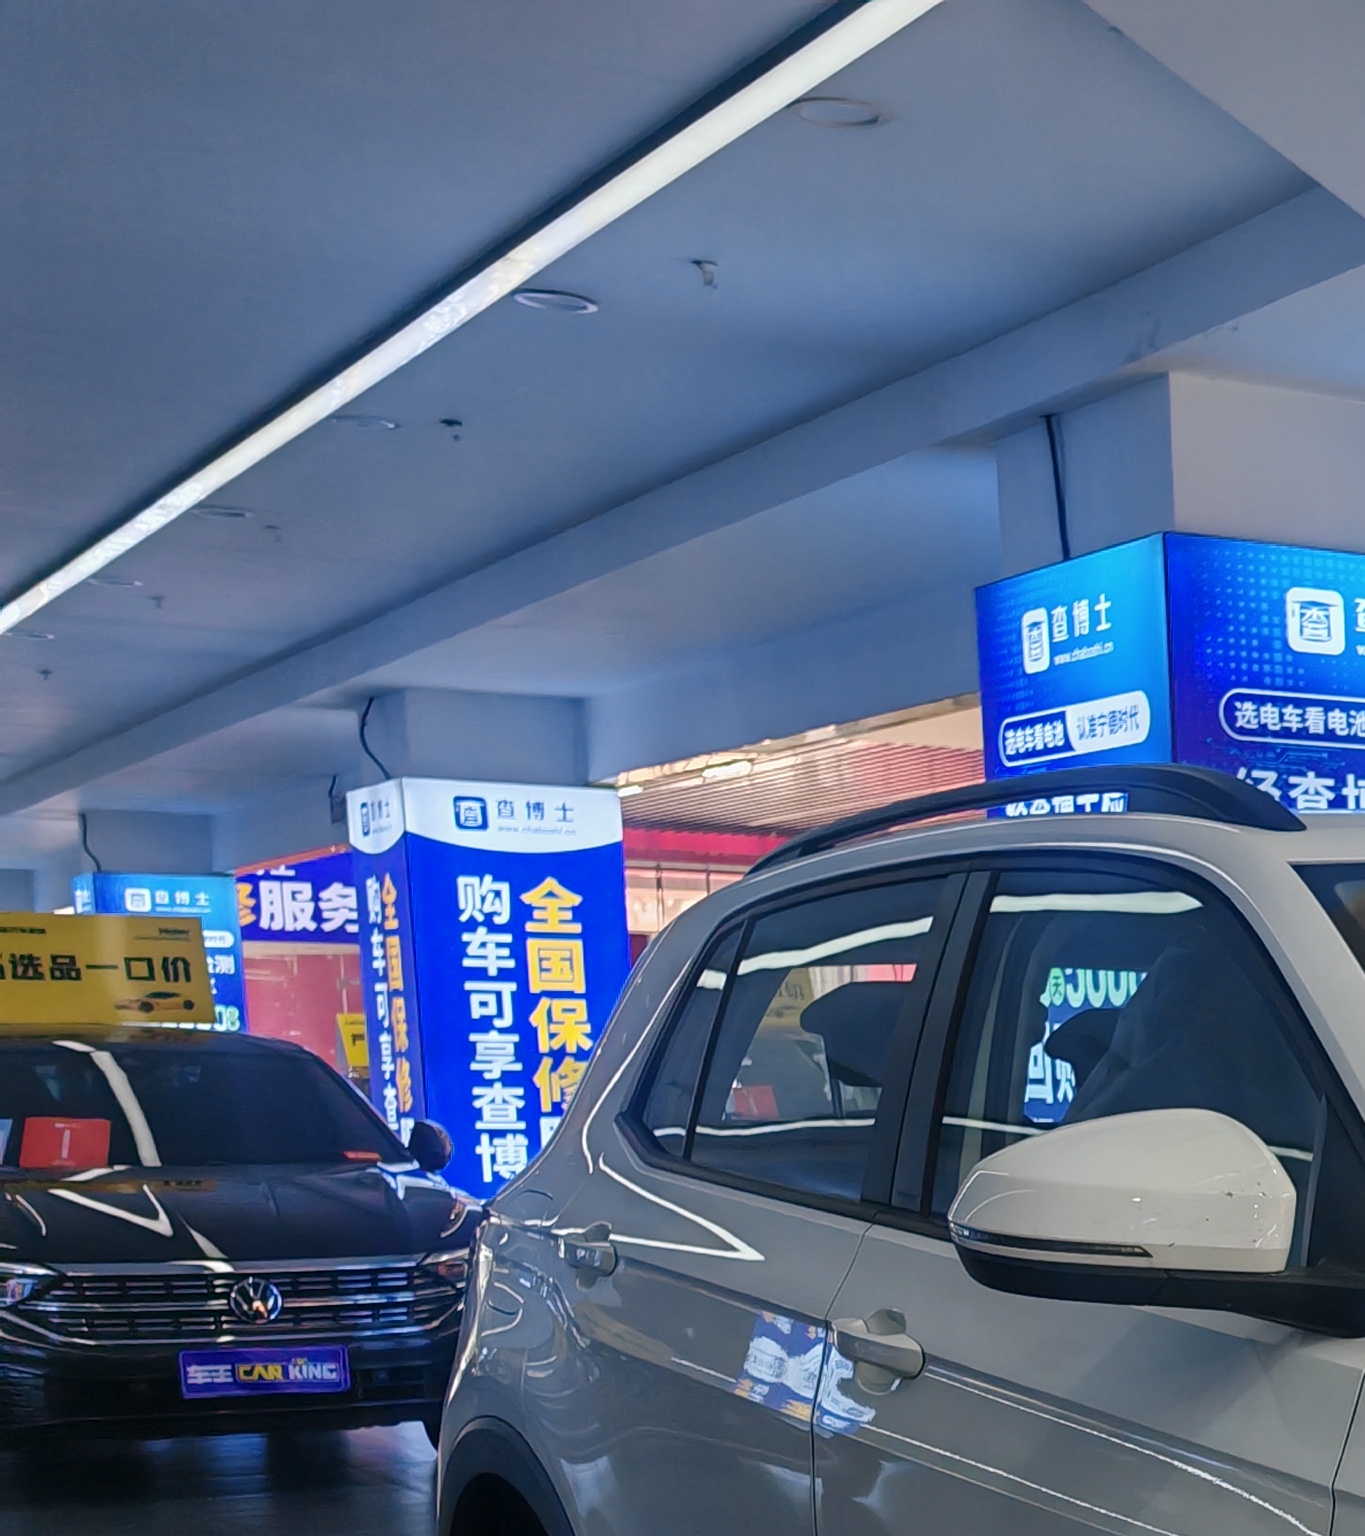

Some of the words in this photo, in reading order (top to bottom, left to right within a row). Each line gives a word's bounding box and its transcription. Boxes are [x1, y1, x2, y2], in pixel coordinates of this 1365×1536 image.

[1051, 593, 1112, 643] 查博士
[495, 799, 575, 823] 查博士
[0, 953, 192, 983] 选品一口价
[236, 1362, 285, 1383] CAR
[288, 1359, 340, 1381] KING
